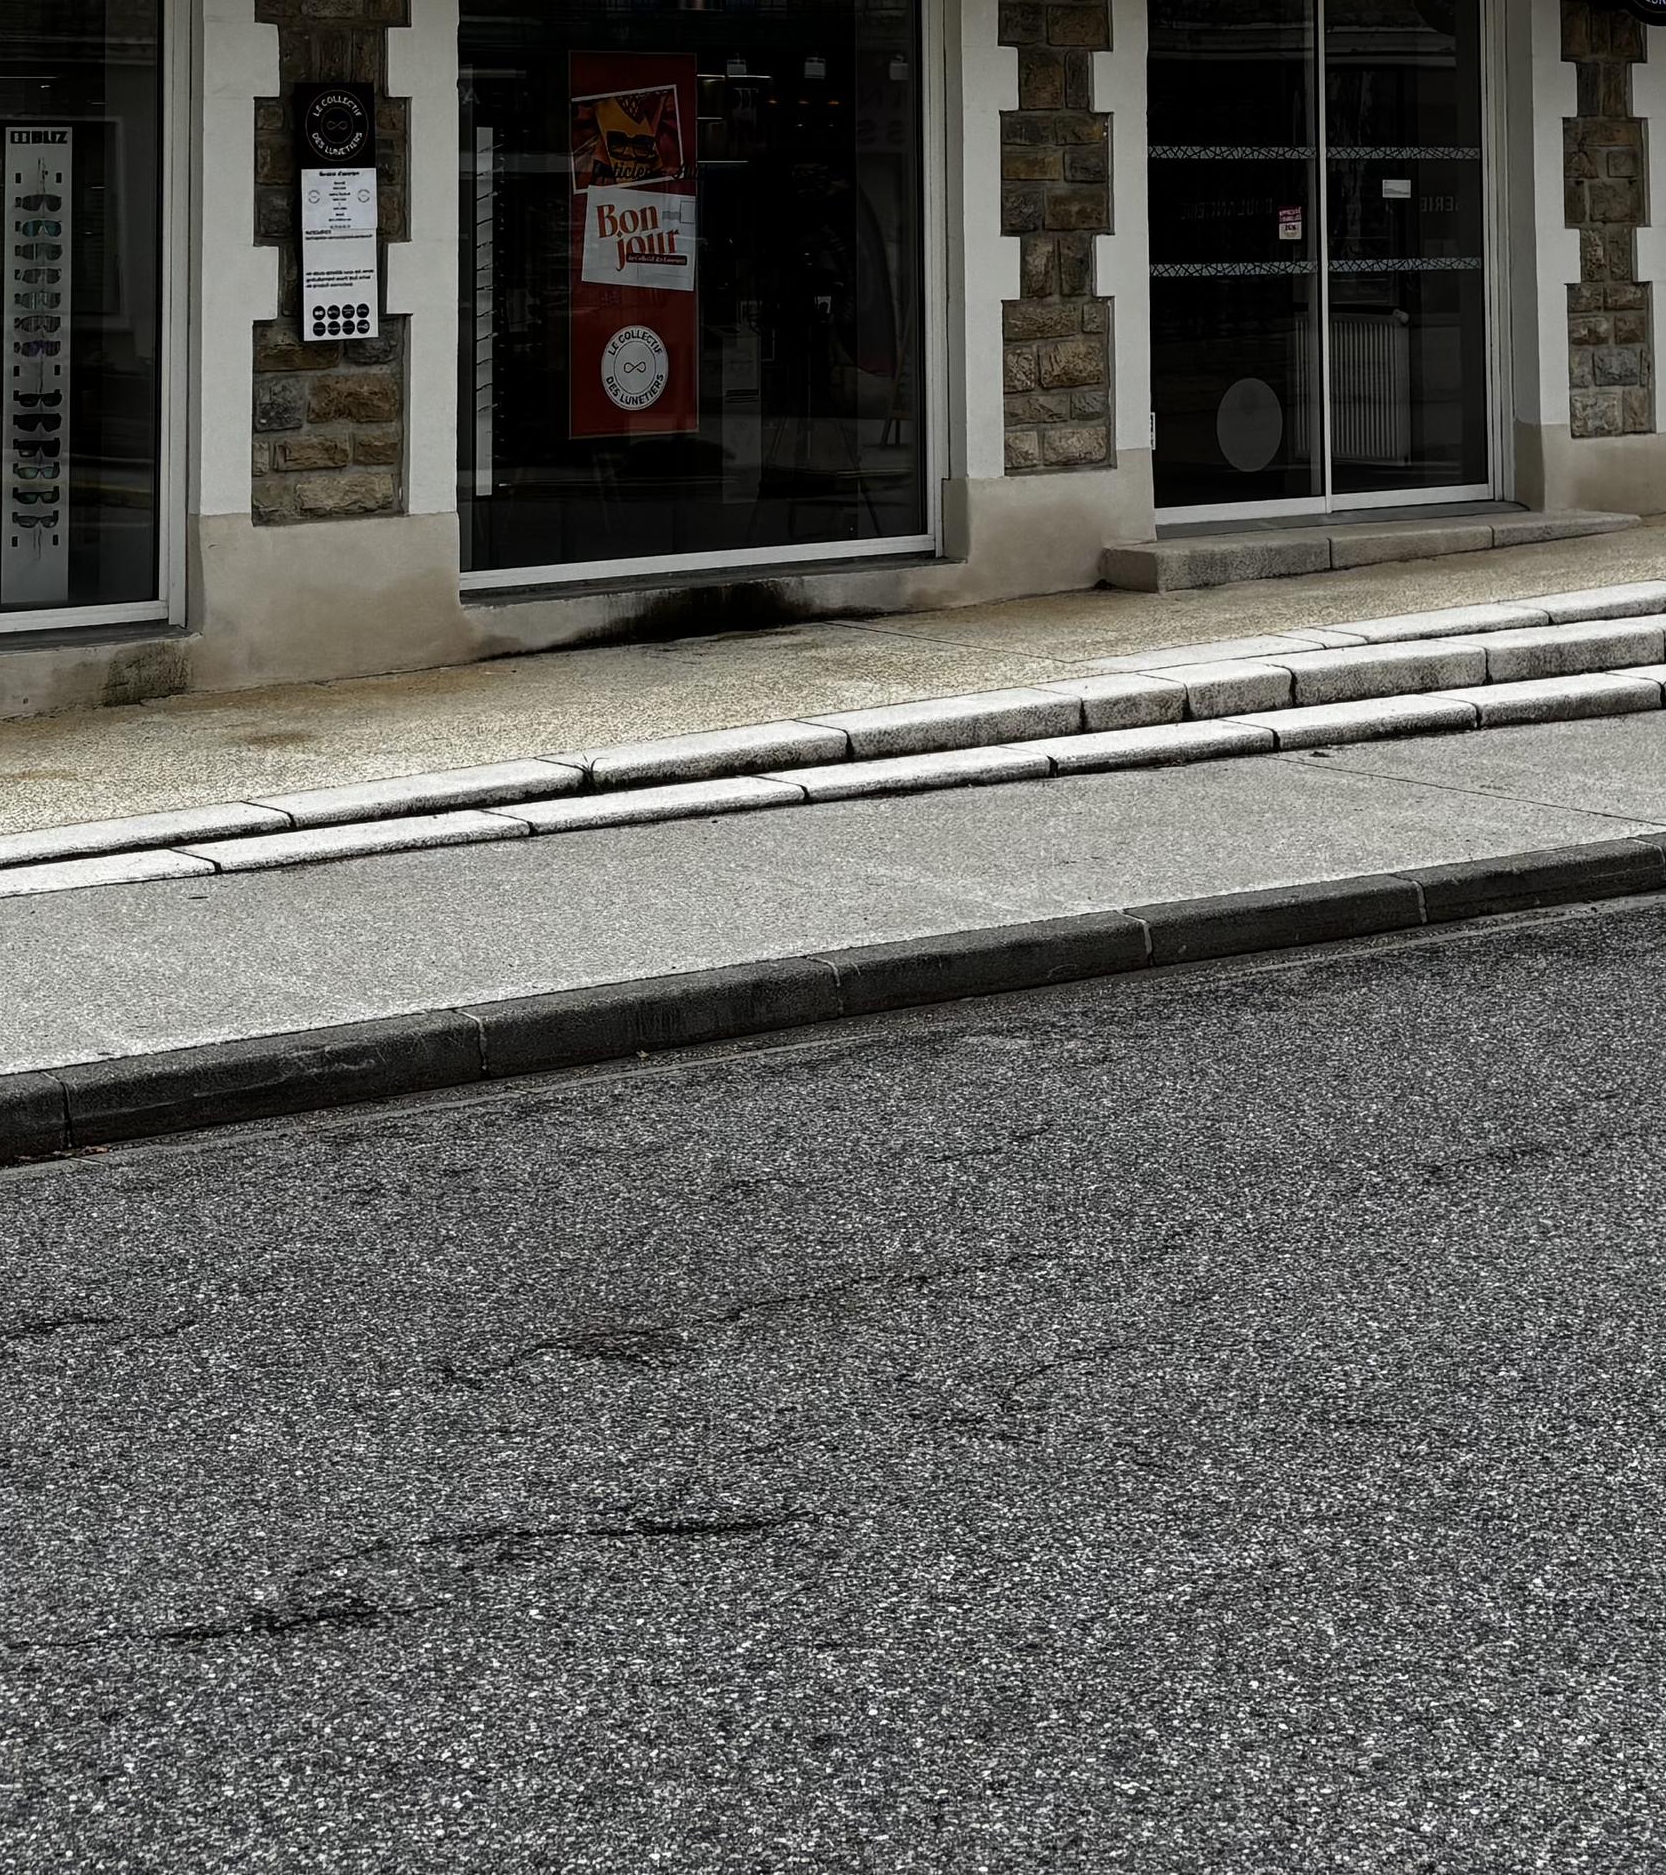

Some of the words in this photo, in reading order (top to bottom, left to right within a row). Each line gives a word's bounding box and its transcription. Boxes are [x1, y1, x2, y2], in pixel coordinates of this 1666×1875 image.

[313, 105, 323, 117] LE
[321, 95, 362, 116] COLLECTIF
[32, 131, 68, 143] BLIZ
[312, 132, 325, 149] DES
[324, 132, 363, 156] LUNETIERS
[596, 204, 659, 239] Bon
[616, 228, 680, 271] jour
[608, 342, 619, 356] LE
[618, 329, 663, 355] COLLECTIF
[606, 376, 620, 397] DES
[620, 374, 664, 405] LUNETIERS
